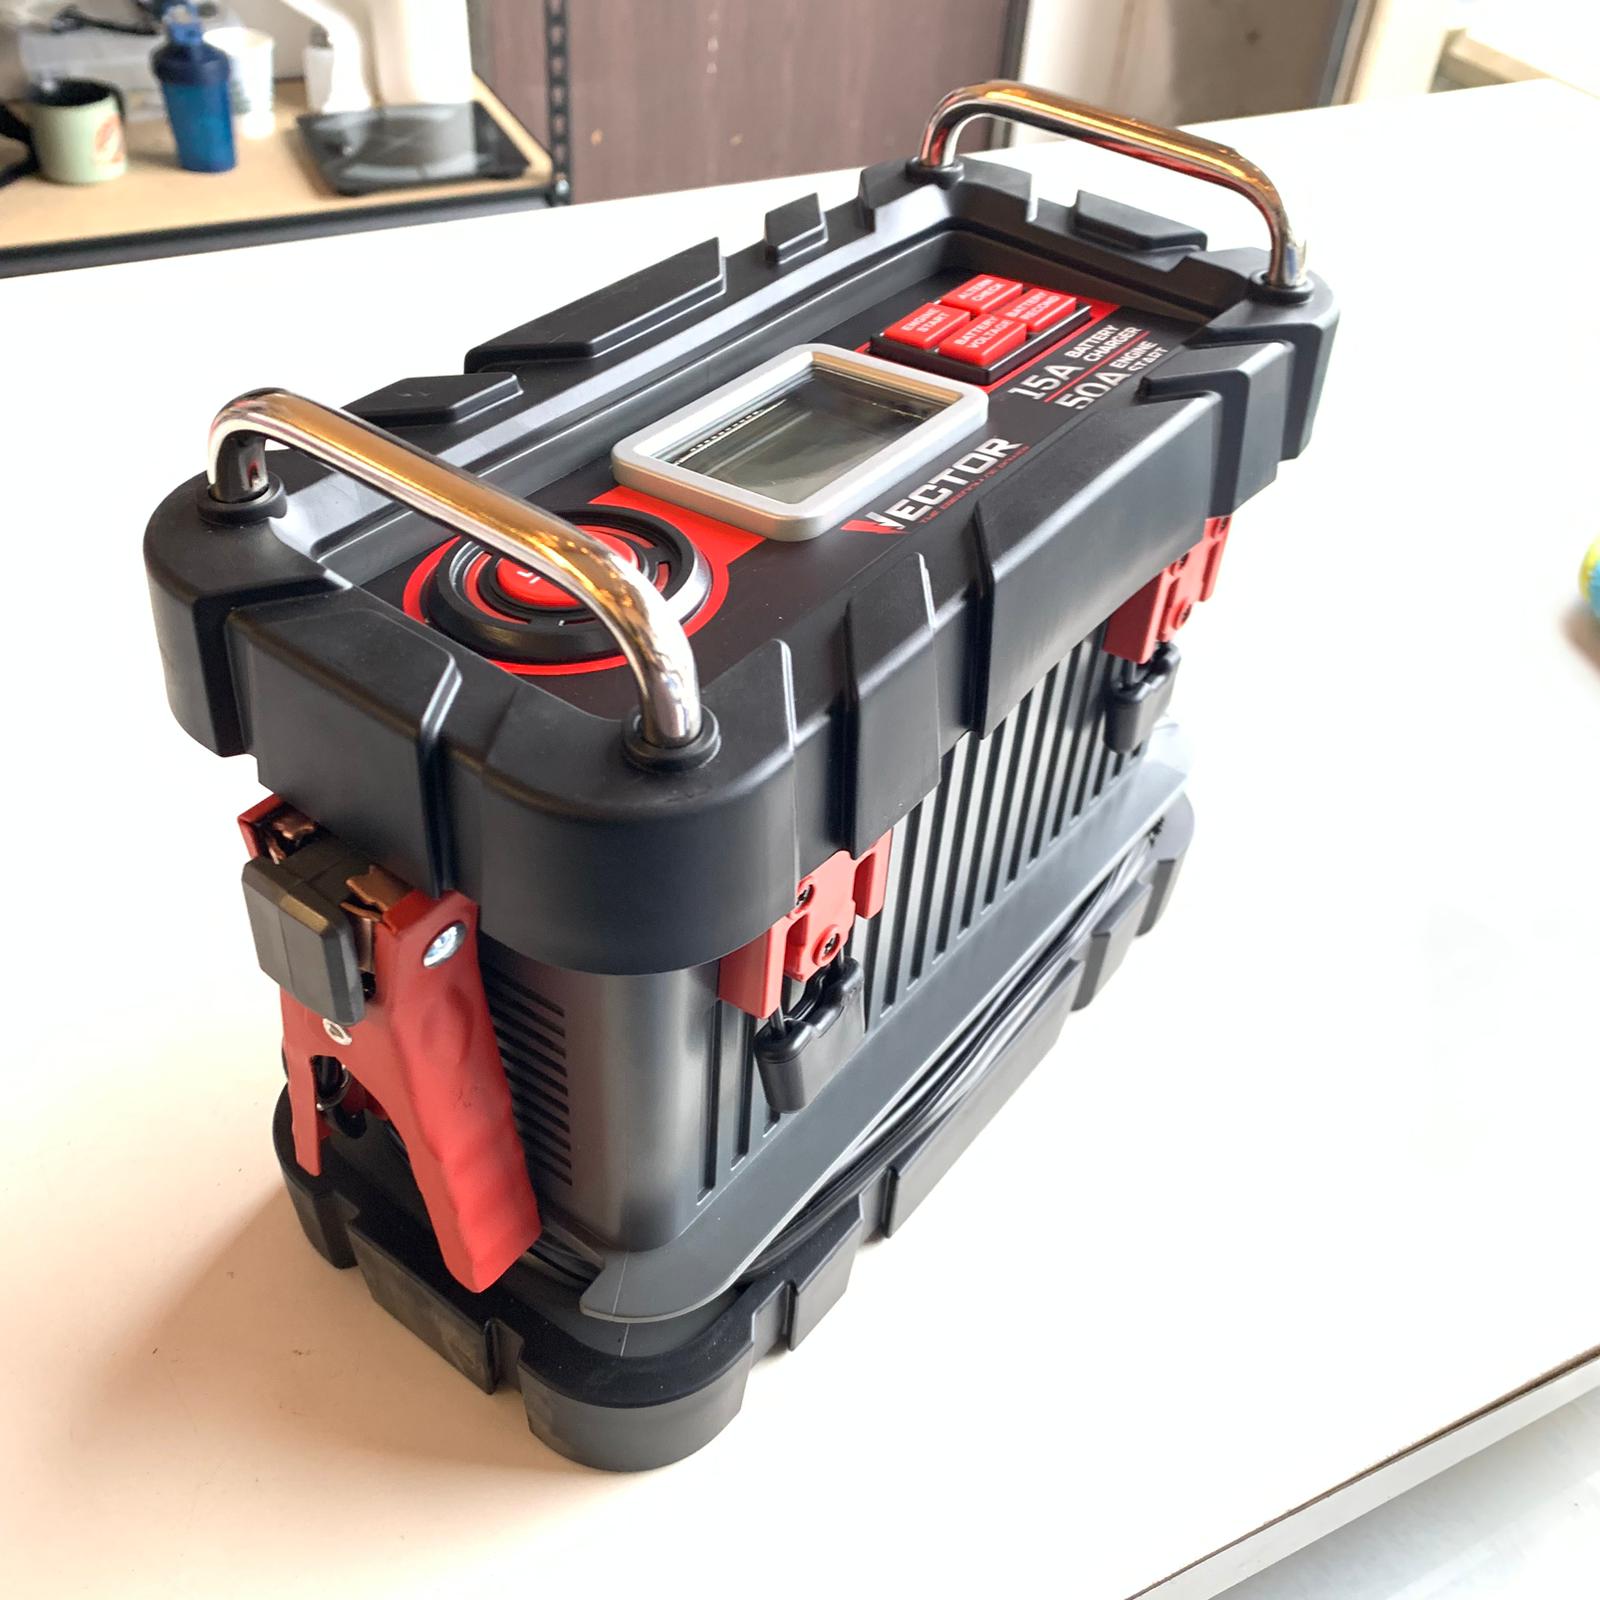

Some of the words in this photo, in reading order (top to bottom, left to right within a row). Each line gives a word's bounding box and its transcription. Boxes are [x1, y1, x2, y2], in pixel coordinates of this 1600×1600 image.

[971, 283, 1006, 302] CHECK
[1005, 291, 1048, 318] BATTERY
[901, 308, 942, 331] ENGINE
[1019, 295, 1061, 320] RECORD
[916, 313, 950, 333] START
[954, 316, 999, 345] BATTERY
[968, 319, 1015, 349] VOLTAGE
[1064, 324, 1120, 358] BATTERY
[1083, 327, 1142, 362] CHARGER
[1109, 340, 1158, 368] ENGINE
[1128, 347, 1169, 371] START
[1007, 364, 1085, 400] 15A
[1054, 372, 1132, 410] 50A
[840, 438, 1023, 534] VECTOR
